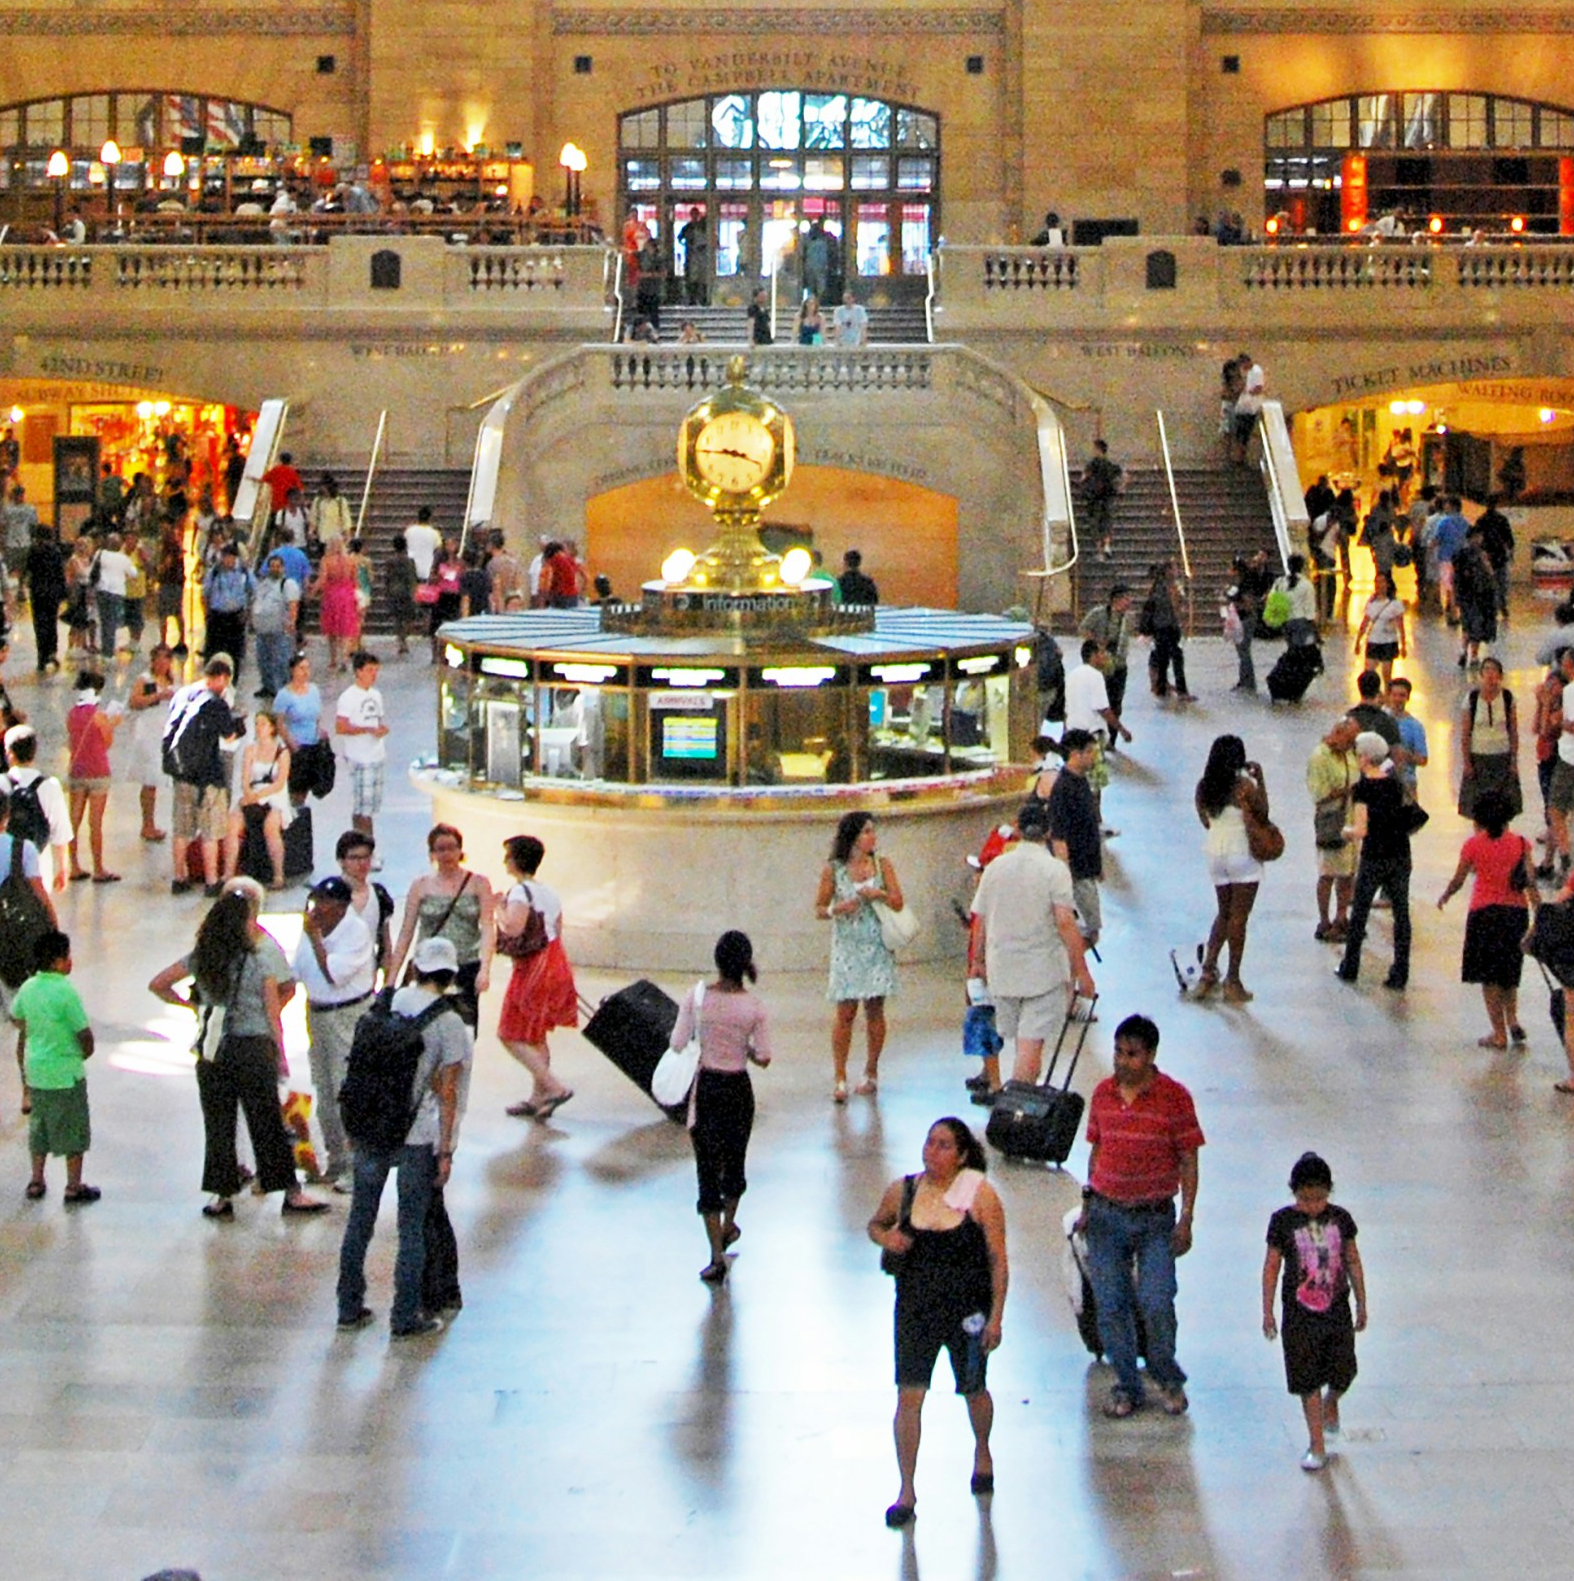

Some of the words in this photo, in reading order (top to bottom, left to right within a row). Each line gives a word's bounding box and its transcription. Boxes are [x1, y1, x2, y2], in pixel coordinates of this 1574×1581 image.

[650, 65, 677, 78] TO
[829, 56, 906, 76] AVENUE
[636, 81, 676, 98] THE
[95, 360, 164, 383] STREET
[1331, 366, 1400, 394] TICKET
[1409, 356, 1512, 379] MACHINES
[1458, 383, 1532, 398] WAITING
[703, 593, 794, 612] Information
[657, 695, 706, 707] ARRIVALS
